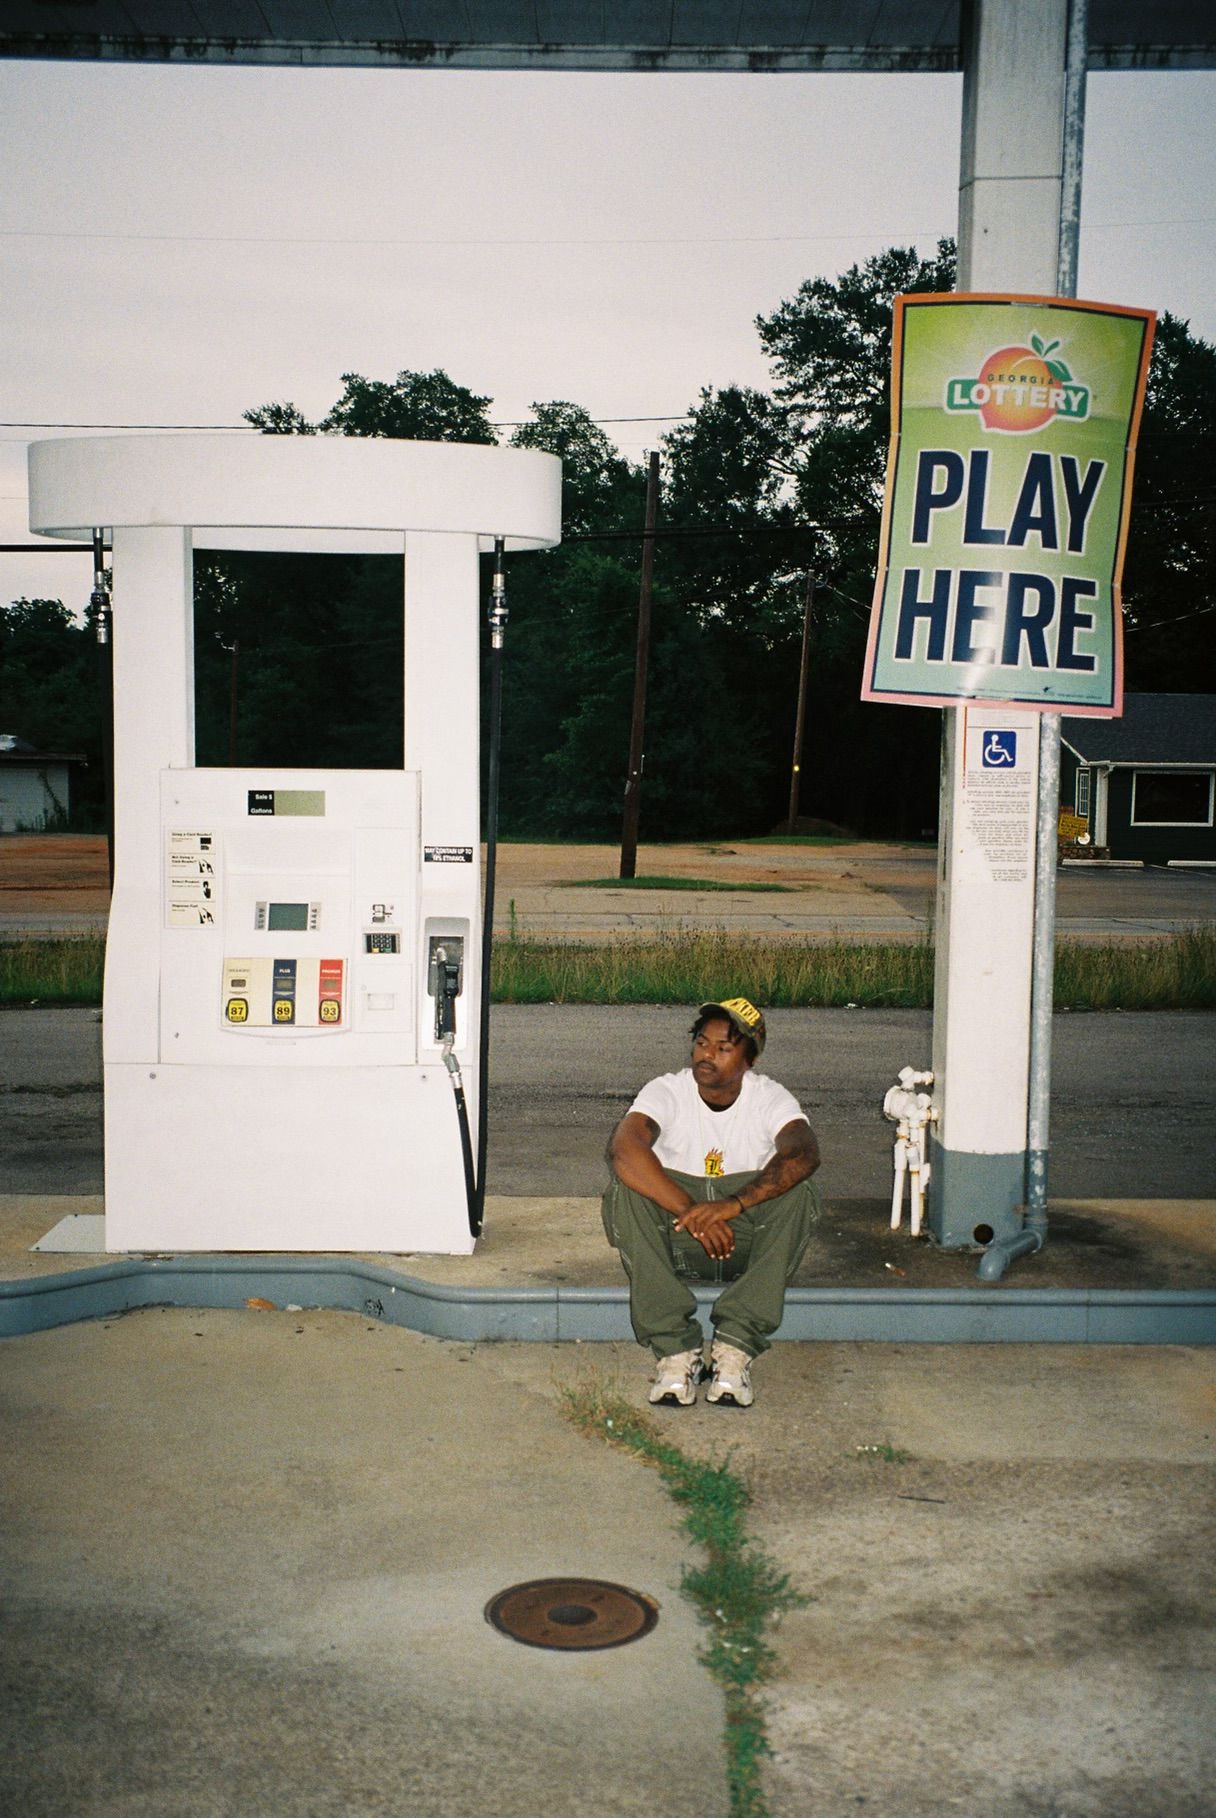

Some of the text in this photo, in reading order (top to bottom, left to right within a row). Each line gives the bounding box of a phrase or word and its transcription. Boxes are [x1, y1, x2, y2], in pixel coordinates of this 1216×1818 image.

[987, 373, 1055, 385] GEORGIA
[952, 383, 1086, 412] LOTTERY
[911, 449, 1106, 553] PLAY
[893, 567, 1098, 672] HERE
[230, 1007, 244, 1015] 87
[276, 1007, 290, 1015] 89
[322, 1007, 337, 1015] 93
